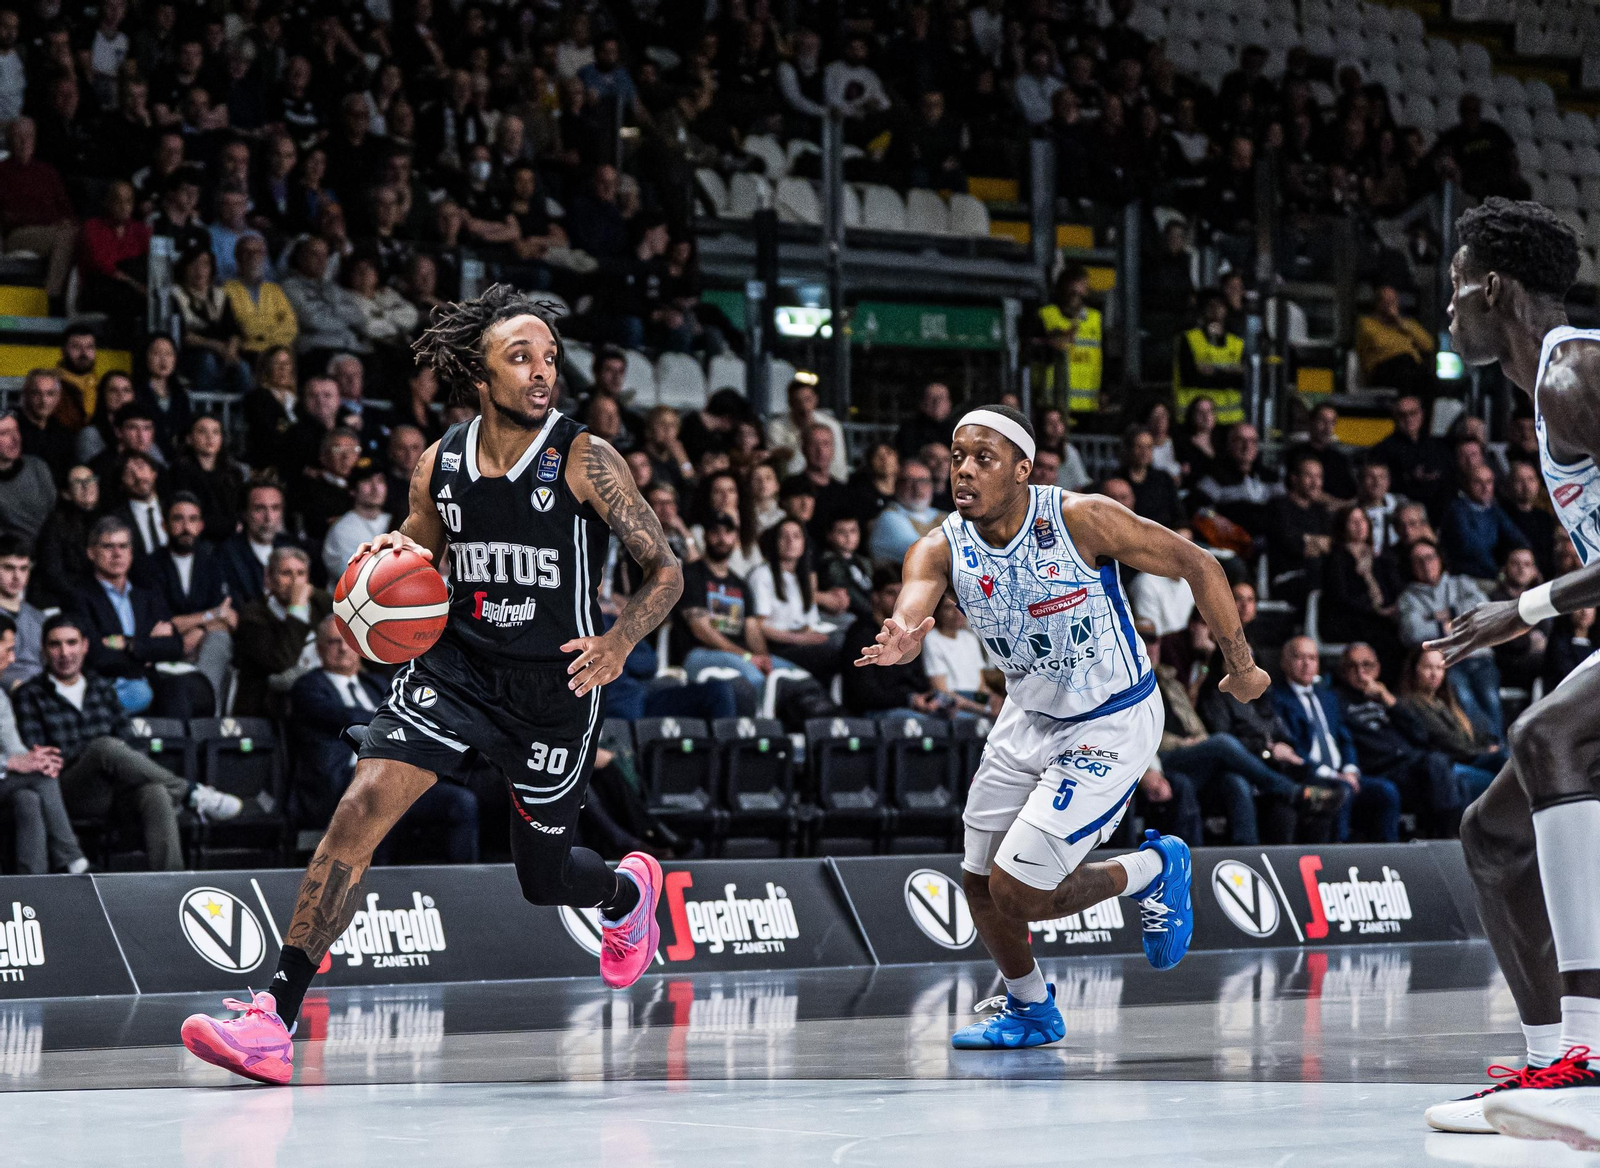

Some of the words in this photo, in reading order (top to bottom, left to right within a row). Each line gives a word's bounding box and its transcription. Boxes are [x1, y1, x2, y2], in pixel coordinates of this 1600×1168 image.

[541, 460, 557, 468] LBA
[963, 545, 978, 568] 5
[471, 591, 537, 623] Segafredo
[413, 628, 442, 641] molt
[526, 741, 569, 775] 30
[1052, 778, 1078, 811] 5
[529, 820, 566, 835] CARS
[1298, 854, 1412, 939] Segafredo
[665, 870, 800, 961] Segafredo
[316, 890, 447, 974] gafredo
[1064, 929, 1112, 944] ZANETTI
[1358, 920, 1401, 934] ZANETTI
[732, 940, 786, 954] ZANETTI
[372, 953, 430, 968] ZANETTI
